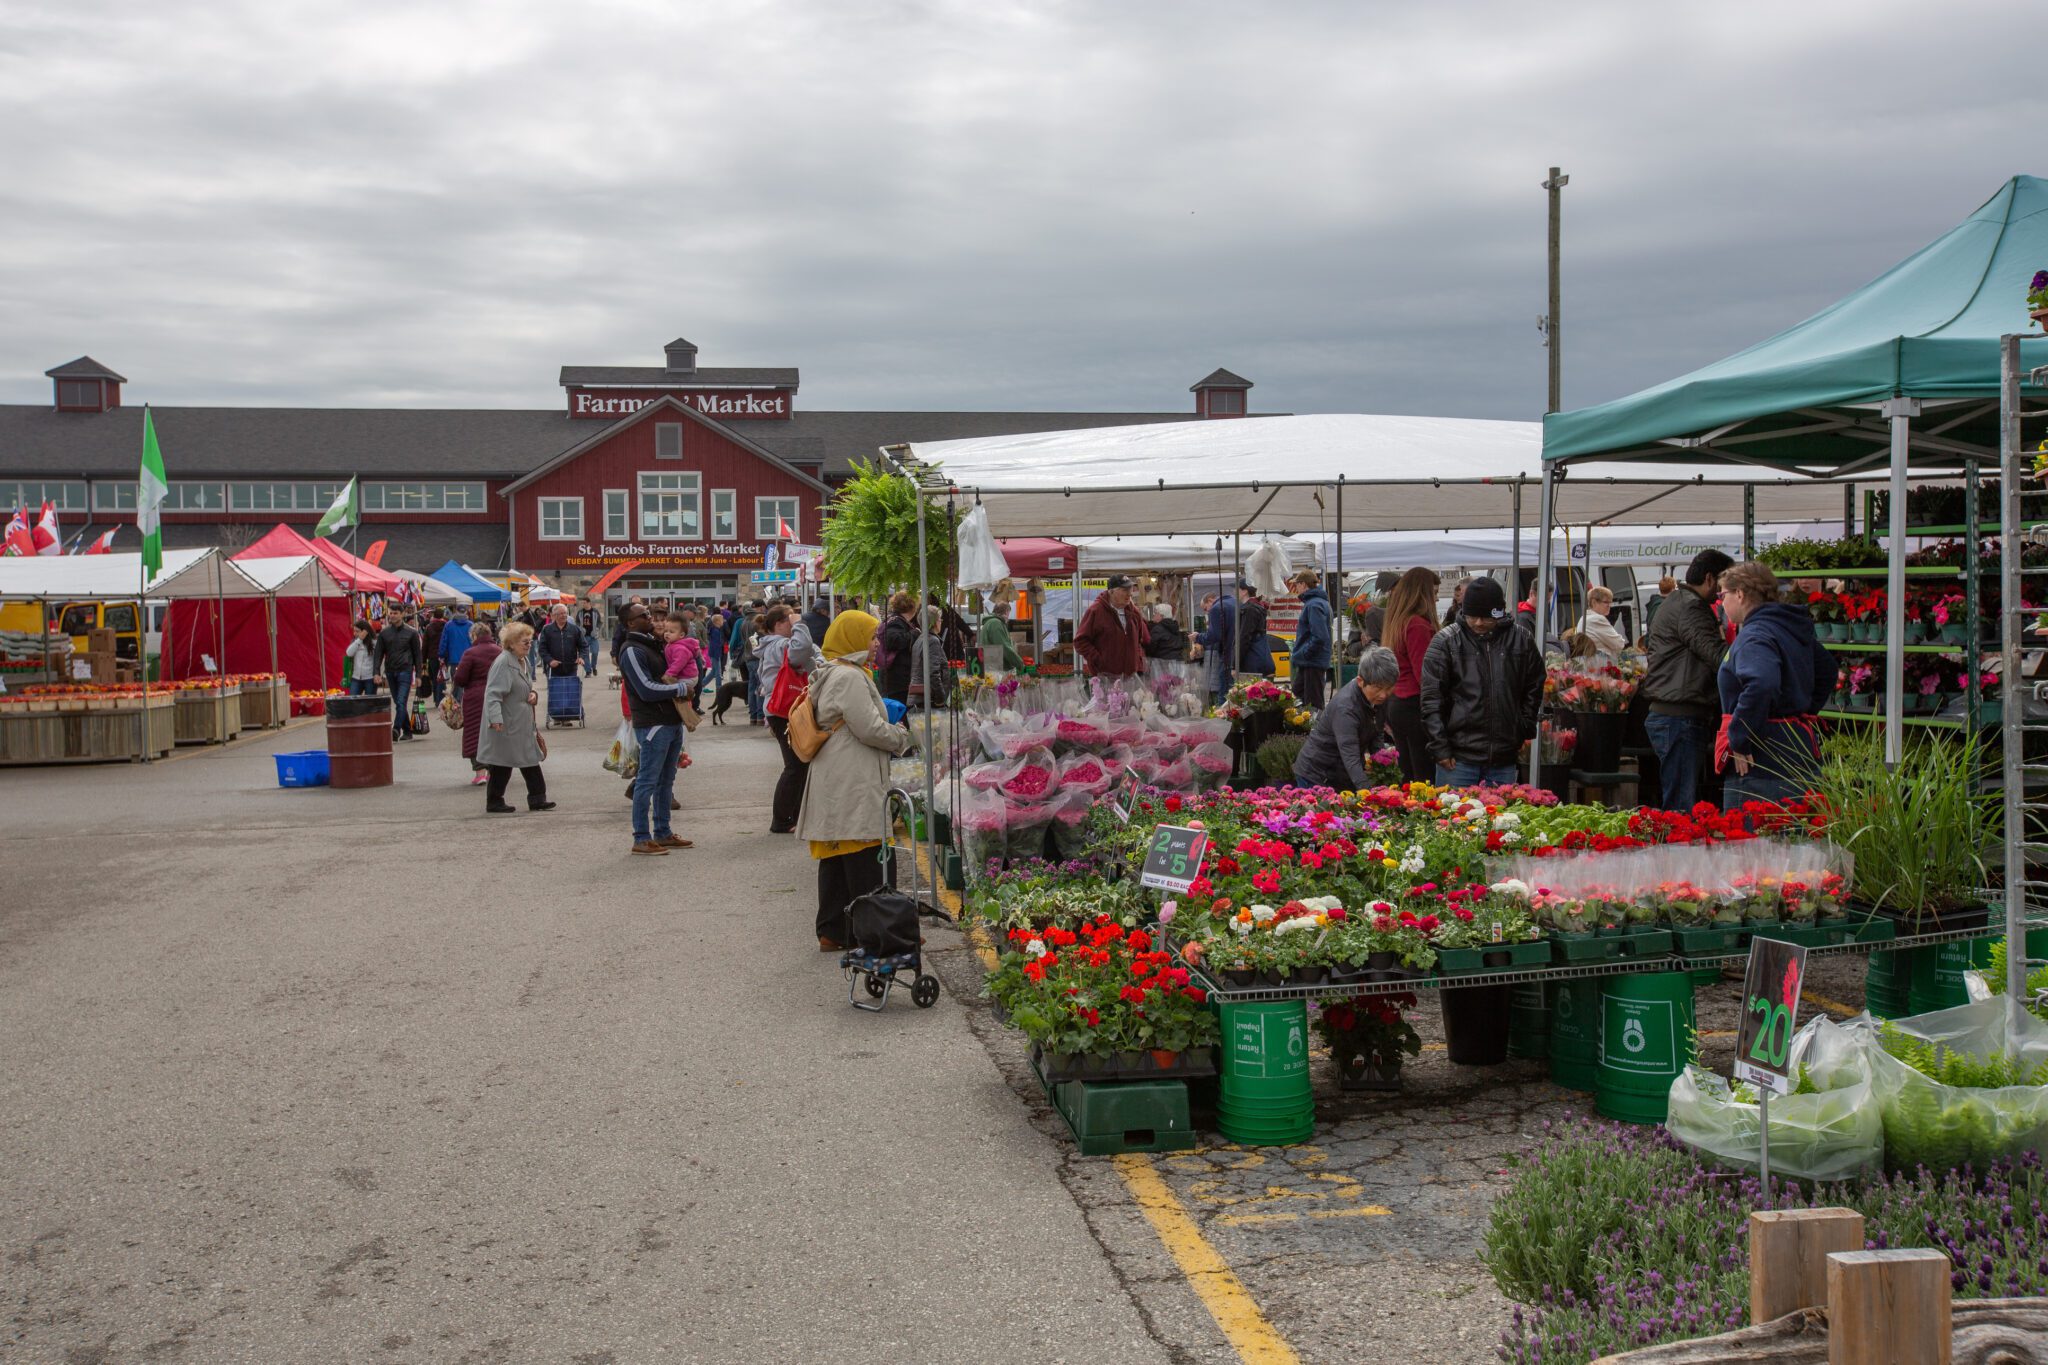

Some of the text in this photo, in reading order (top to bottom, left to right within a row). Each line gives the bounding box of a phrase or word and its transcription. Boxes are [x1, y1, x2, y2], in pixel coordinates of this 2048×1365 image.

[576, 393, 785, 414] Farm' Market
[579, 543, 760, 558] St. Jacobs Farmers' Market
[1598, 549, 1634, 558] VERIFIED
[1638, 542, 1672, 557] Local
[566, 557, 601, 565] TUESDAY
[674, 557, 693, 565] Open
[1155, 831, 1171, 852] 2
[1941, 953, 1967, 963] Return
[1236, 1022, 1260, 1033] Deposit
[1748, 994, 1791, 1067] $20
[1243, 1034, 1252, 1043] for
[1237, 1044, 1260, 1054] Return
